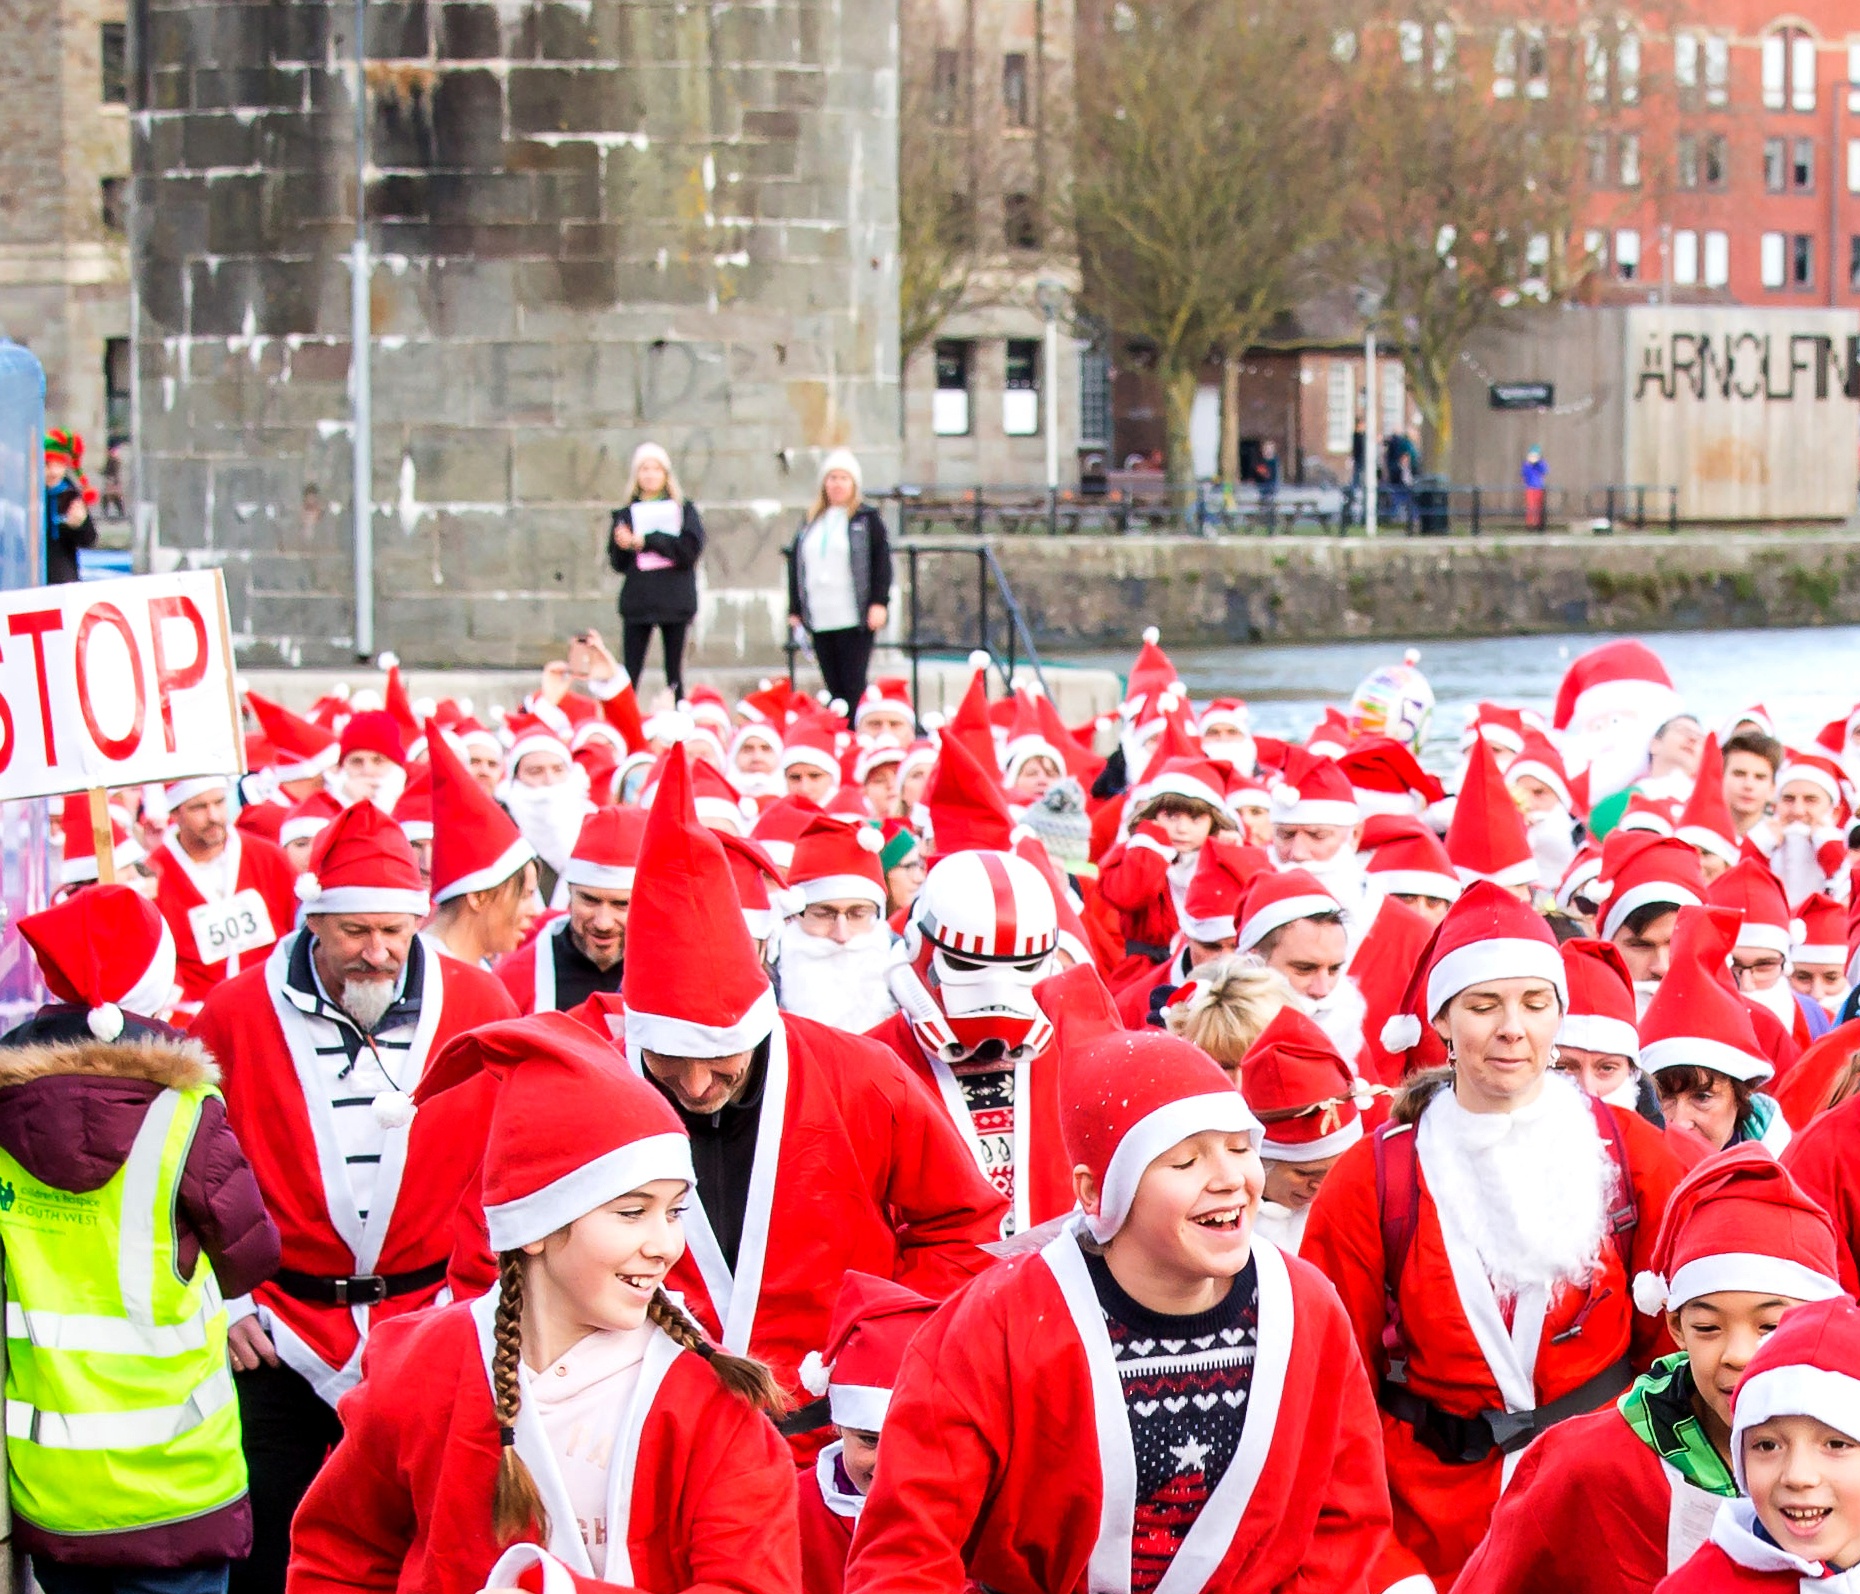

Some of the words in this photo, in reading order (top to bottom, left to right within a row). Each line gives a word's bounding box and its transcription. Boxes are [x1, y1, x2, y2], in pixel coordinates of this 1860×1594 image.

[0, 596, 209, 773] TOP
[208, 911, 257, 946] 503
[17, 1202, 60, 1220] SOUTH
[63, 1213, 98, 1226] WEST
